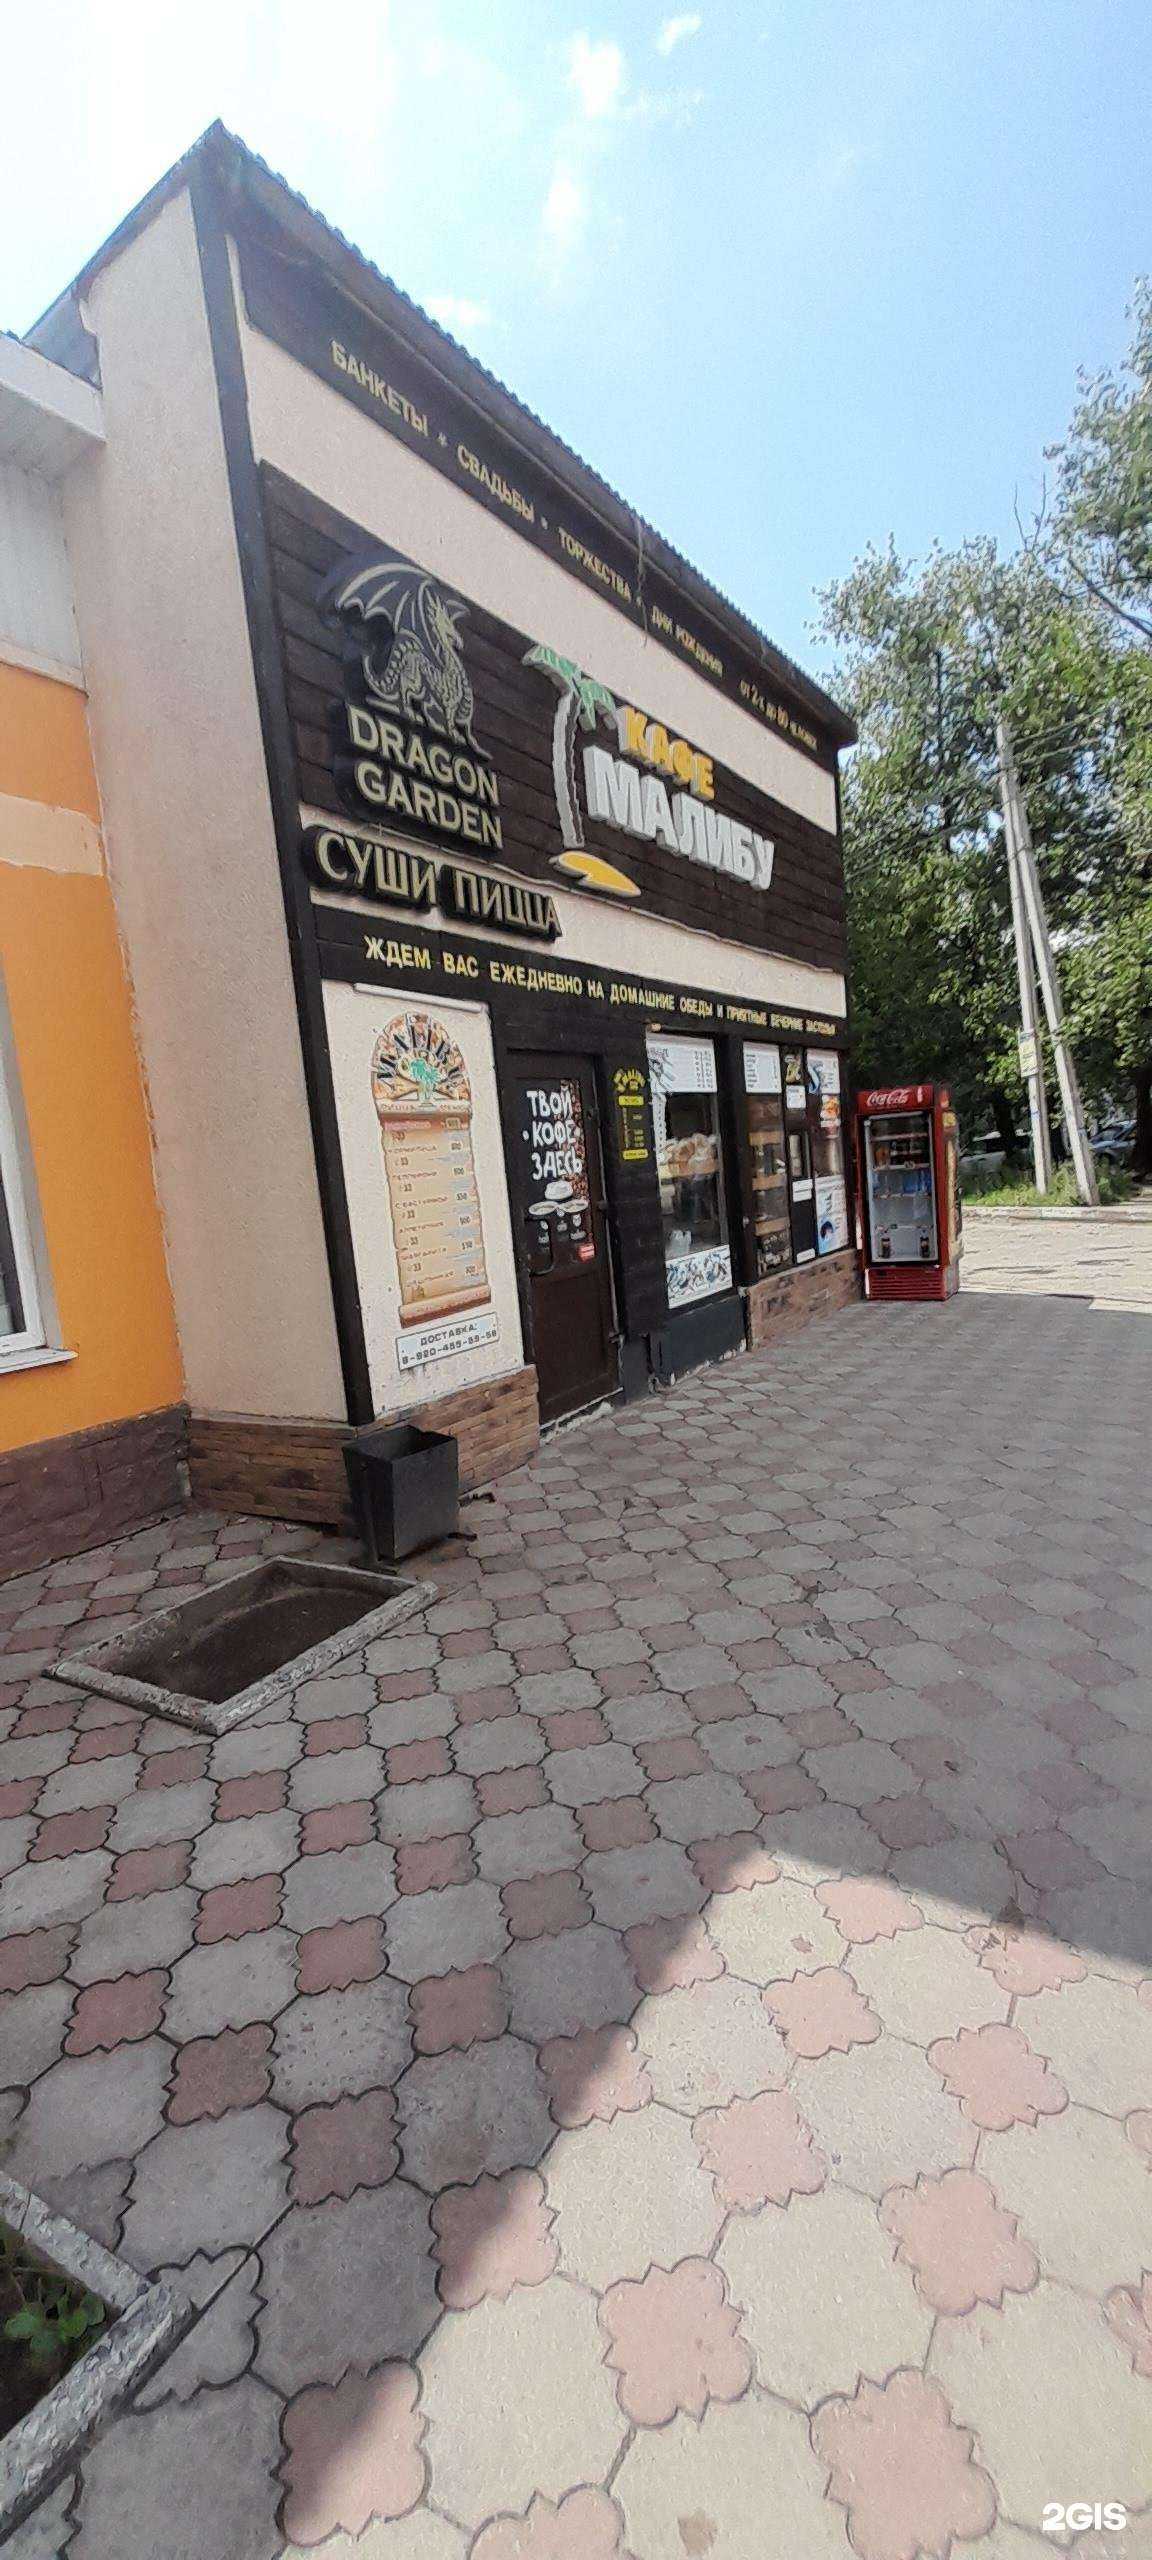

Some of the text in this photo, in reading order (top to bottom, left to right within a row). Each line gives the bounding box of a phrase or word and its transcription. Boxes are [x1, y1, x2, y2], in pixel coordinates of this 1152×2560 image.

[331, 339, 429, 437] БАНКЕТЫ
[457, 444, 534, 523] СВАДЬБЫ
[558, 526, 631, 602] ТОРЖЕСТВА
[652, 605, 673, 636] ДНИ
[675, 624, 723, 679] РОЖДЕНИЯ
[350, 704, 499, 806] DRAGON
[618, 704, 715, 801] КАФЕ
[356, 761, 503, 849] GARDEN
[584, 746, 775, 891] МАЛИБУ
[316, 831, 562, 936] СУШИ ПИЦЦА
[363, 935, 431, 970] ЖДЕМ
[442, 951, 479, 978] ВАС
[490, 960, 583, 995] ЕЖЕДНЕВНО
[588, 980, 604, 999] НА
[610, 984, 675, 1011] ДОМАШНИЕ
[679, 996, 713, 1018] ОБЕДЫ
[717, 1004, 723, 1018] И
[526, 1086, 573, 1120] ТВОЙ
[532, 1119, 577, 1149] КОФЕ
[531, 1148, 582, 1181] ЗДЕСЬ
[420, 1322, 477, 1346] ДОСТАВКА:
